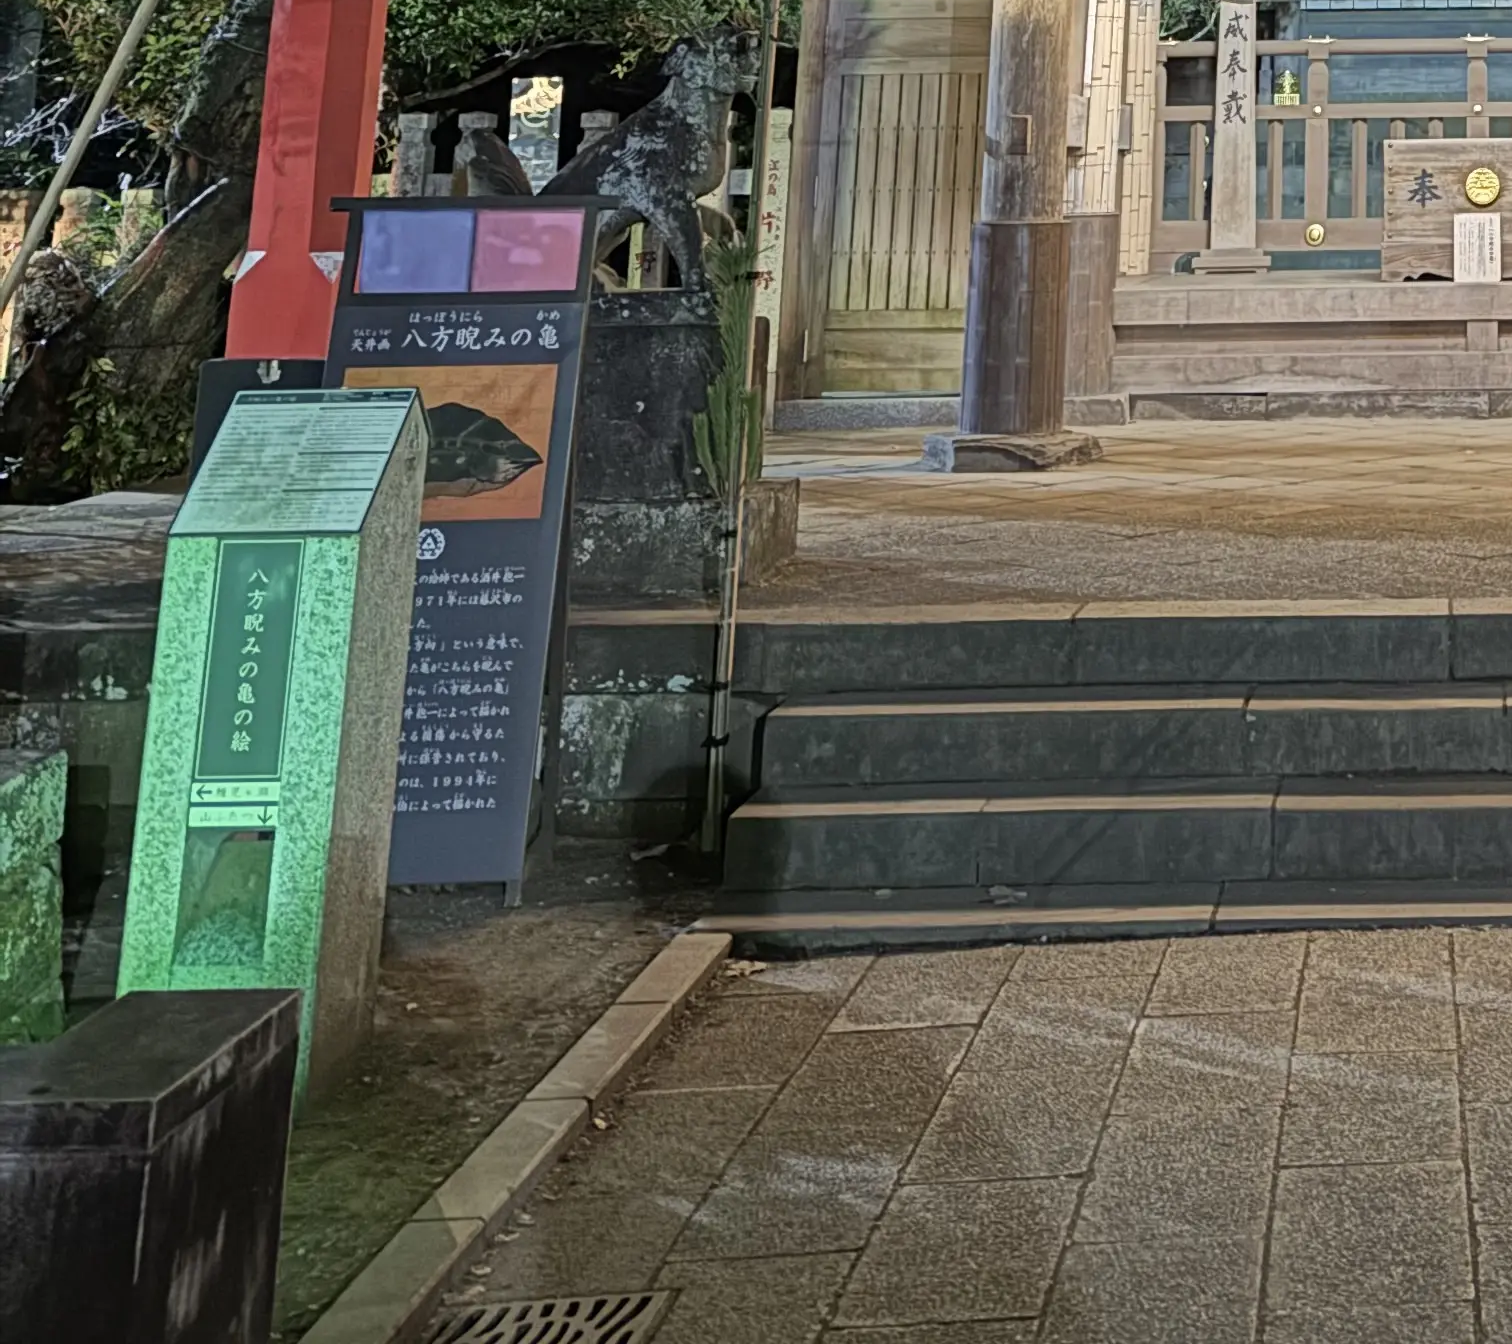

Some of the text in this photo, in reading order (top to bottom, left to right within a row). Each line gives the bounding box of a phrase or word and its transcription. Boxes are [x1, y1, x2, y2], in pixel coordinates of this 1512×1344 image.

[401, 323, 560, 353] 八方睨みの亀
[230, 567, 271, 752] 八方睨みの亀の絵
